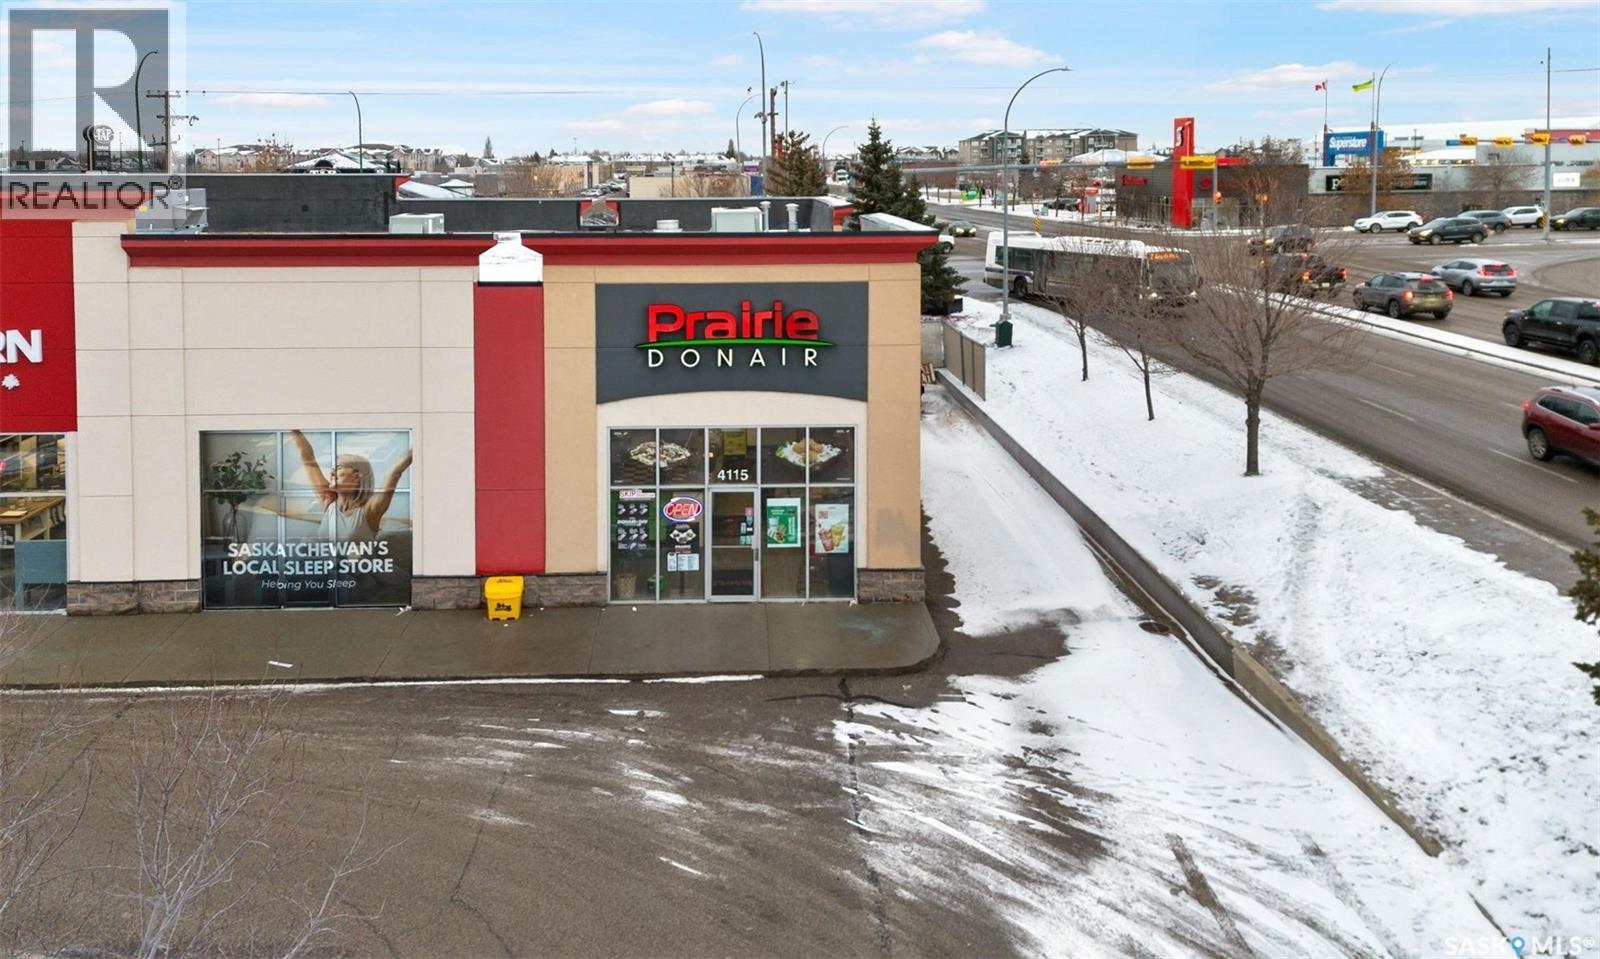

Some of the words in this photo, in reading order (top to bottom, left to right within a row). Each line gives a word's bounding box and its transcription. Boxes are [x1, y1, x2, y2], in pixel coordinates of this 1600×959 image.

[1328, 136, 1368, 150] Superstore
[647, 299, 820, 342] Prairie
[648, 348, 818, 368] DONAIR
[717, 468, 749, 482] 4115
[666, 503, 699, 516] OPEN
[227, 541, 389, 558] SASKATCHEWAN'S
[222, 561, 279, 576] LOCAL
[284, 560, 334, 575] SLEEP
[338, 558, 393, 573] STORE
[305, 580, 325, 590] You
[327, 578, 357, 590] Sleep
